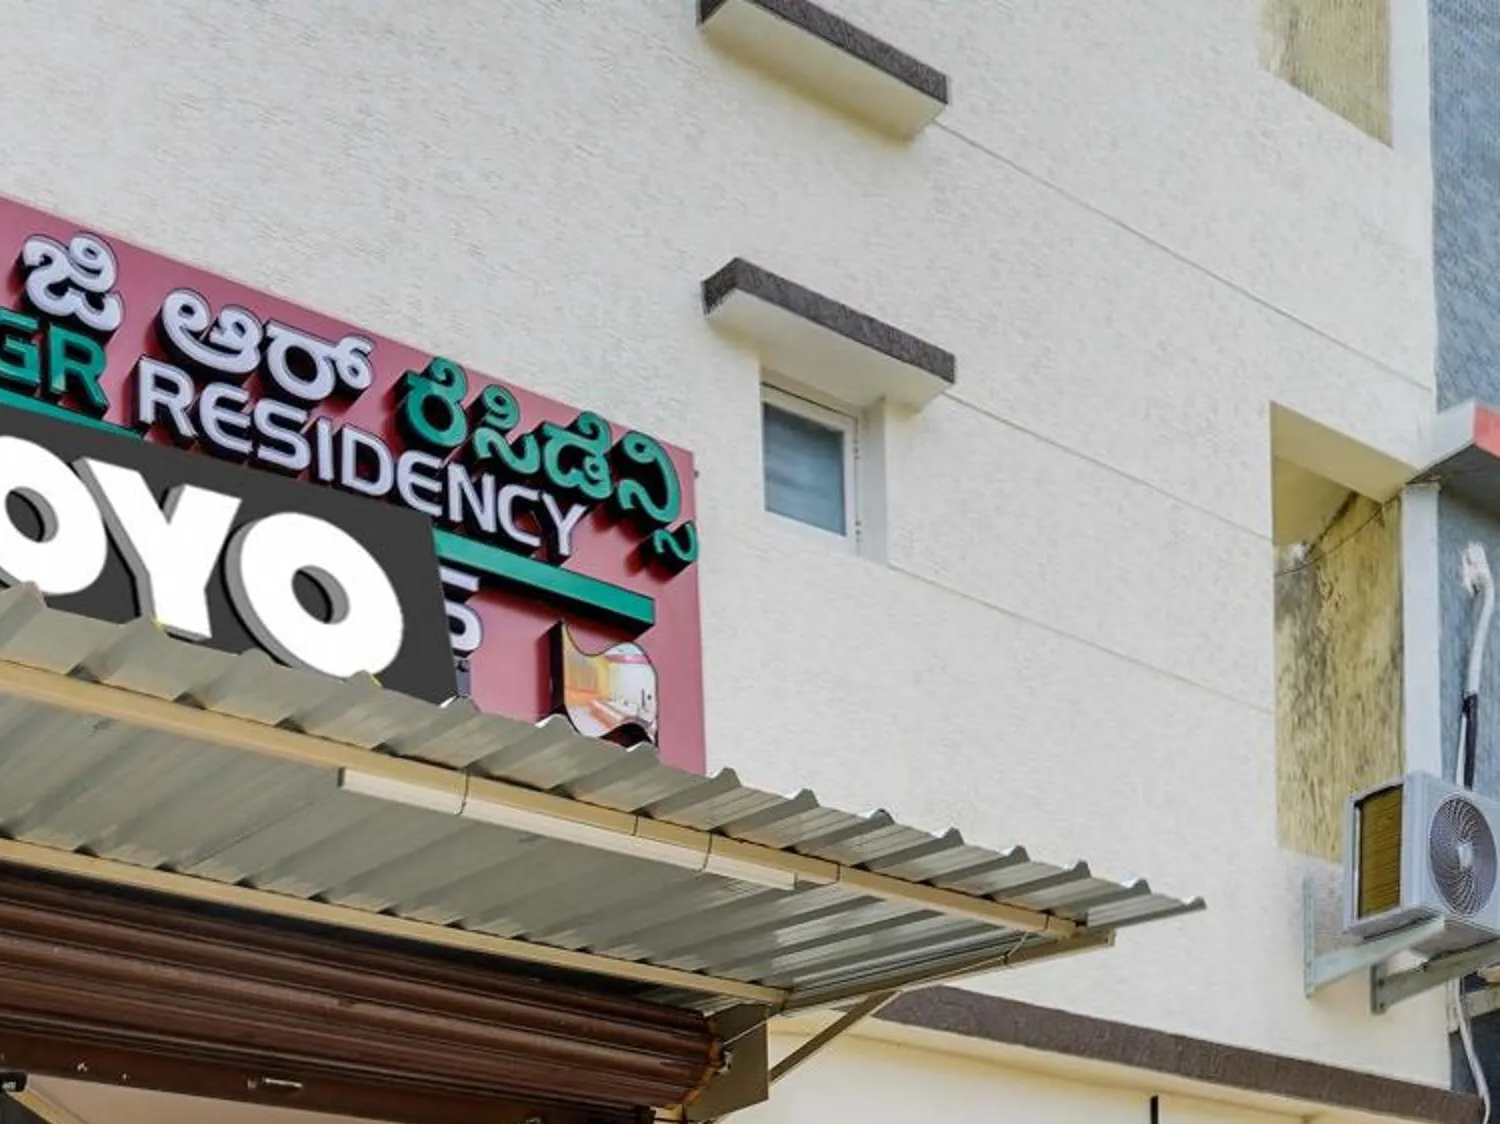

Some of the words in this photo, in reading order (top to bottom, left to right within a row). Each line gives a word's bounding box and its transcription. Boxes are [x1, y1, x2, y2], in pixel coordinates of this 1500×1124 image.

[21, 231, 125, 332] ಜಿ
[160, 288, 374, 400] ಆರ್
[140, 358, 586, 557] RESIDENCY
